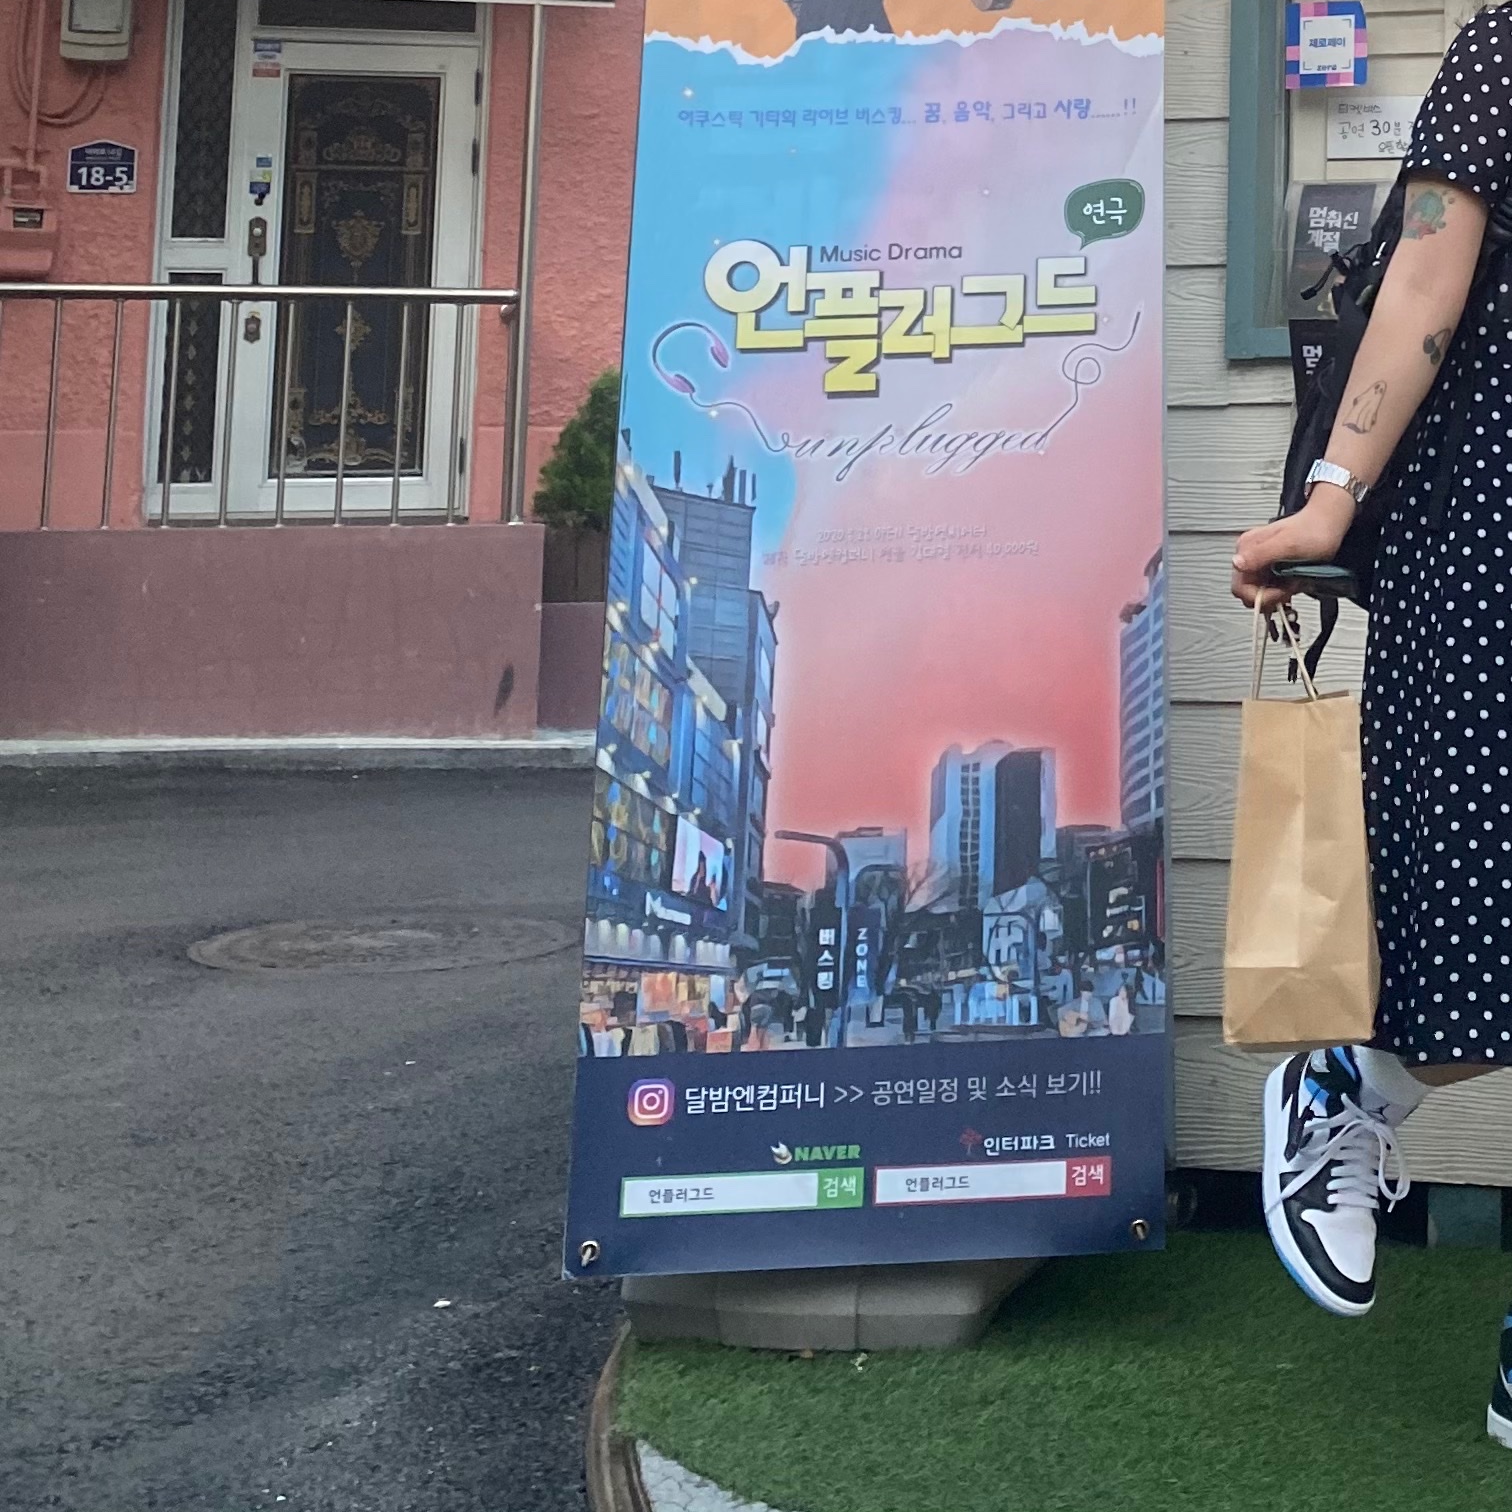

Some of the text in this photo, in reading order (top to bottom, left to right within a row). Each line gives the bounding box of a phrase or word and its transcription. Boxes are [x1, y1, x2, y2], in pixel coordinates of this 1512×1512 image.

[677, 109, 744, 128] 어쿠스틱
[749, 109, 797, 128] 기타의
[802, 107, 849, 127] 라이브
[1001, 101, 1048, 121] 그리고
[1337, 120, 1365, 140] 공연
[77, 166, 128, 187] 18-5
[1082, 197, 1128, 226] 연극
[819, 242, 963, 264] Music Drama
[703, 238, 1099, 397] 언플러그드
[788, 402, 1047, 482] unplugged
[816, 927, 836, 991] 버스킹
[855, 927, 869, 988] ZONE
[684, 1082, 826, 1116] 달밤엔컴퍼니
[870, 1074, 960, 1110] 공연일정
[966, 1076, 988, 1102] 및
[994, 1071, 1039, 1102] 소식
[1045, 1069, 1102, 1098] 보기!!
[794, 1144, 862, 1163] NAVER
[982, 1130, 1111, 1157] 인터파크 Ticket
[648, 1175, 858, 1205] 언플러그드 검색
[904, 1163, 1106, 1193] 언플러그드 검색
